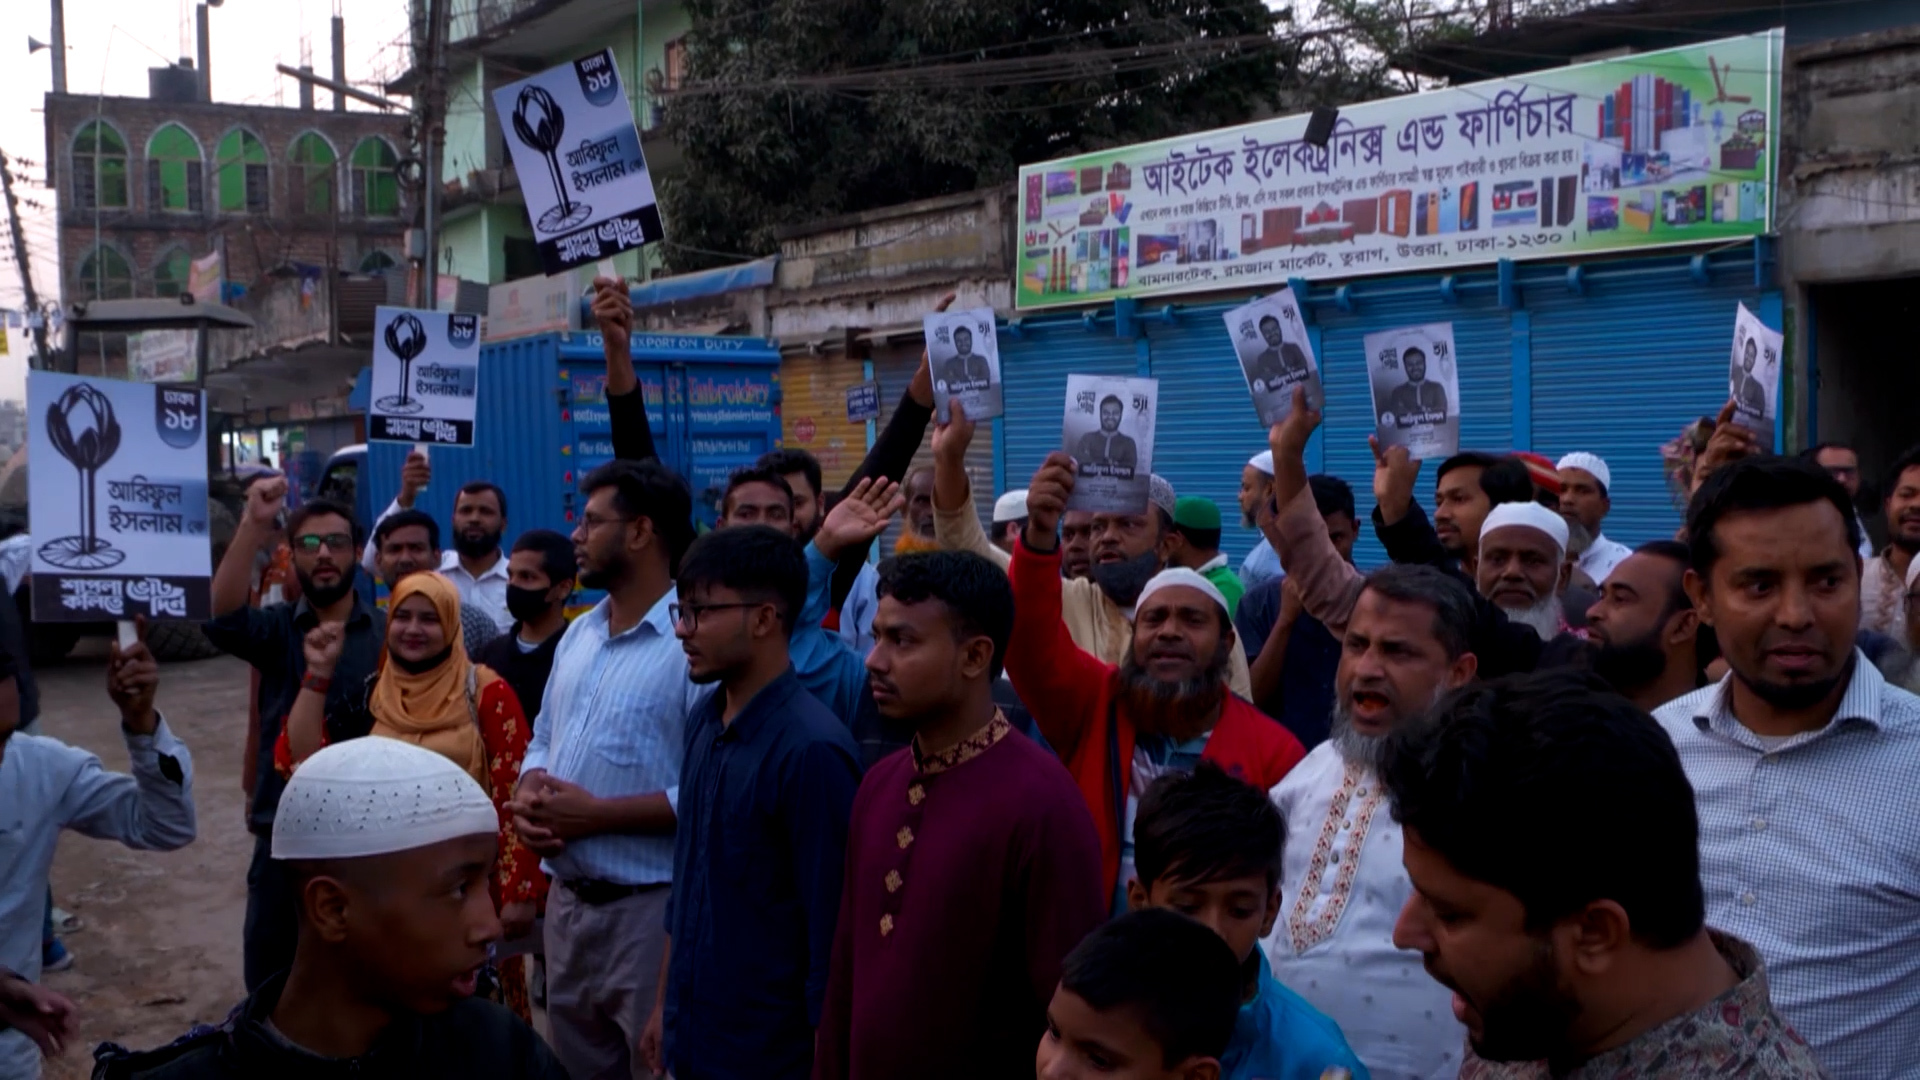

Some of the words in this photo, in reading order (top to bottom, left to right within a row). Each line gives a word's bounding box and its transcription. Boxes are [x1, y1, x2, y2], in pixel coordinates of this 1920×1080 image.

[581, 53, 606, 72] ঢাকা
[588, 69, 612, 92] ১৮
[565, 134, 620, 168] আরিফুল
[1142, 143, 1236, 196] আইটেক
[1397, 115, 1448, 157] এন্ড
[1456, 84, 1578, 148] ফার্ণিচার
[571, 160, 626, 193] ইসলাম
[1224, 260, 1274, 278] রমজান
[1396, 241, 1448, 258] উত্তরা,
[679, 338, 697, 349] ON
[704, 339, 743, 350] DUTY
[163, 389, 196, 405] ঢাকা
[164, 409, 198, 430] ১৮
[107, 473, 182, 510] আরিফুল
[107, 505, 183, 535] ইসলাম
[60, 577, 123, 597] শাপলা
[126, 576, 173, 601] ভোট
[61, 593, 124, 615] কলিতে
[150, 587, 187, 618] দিন
